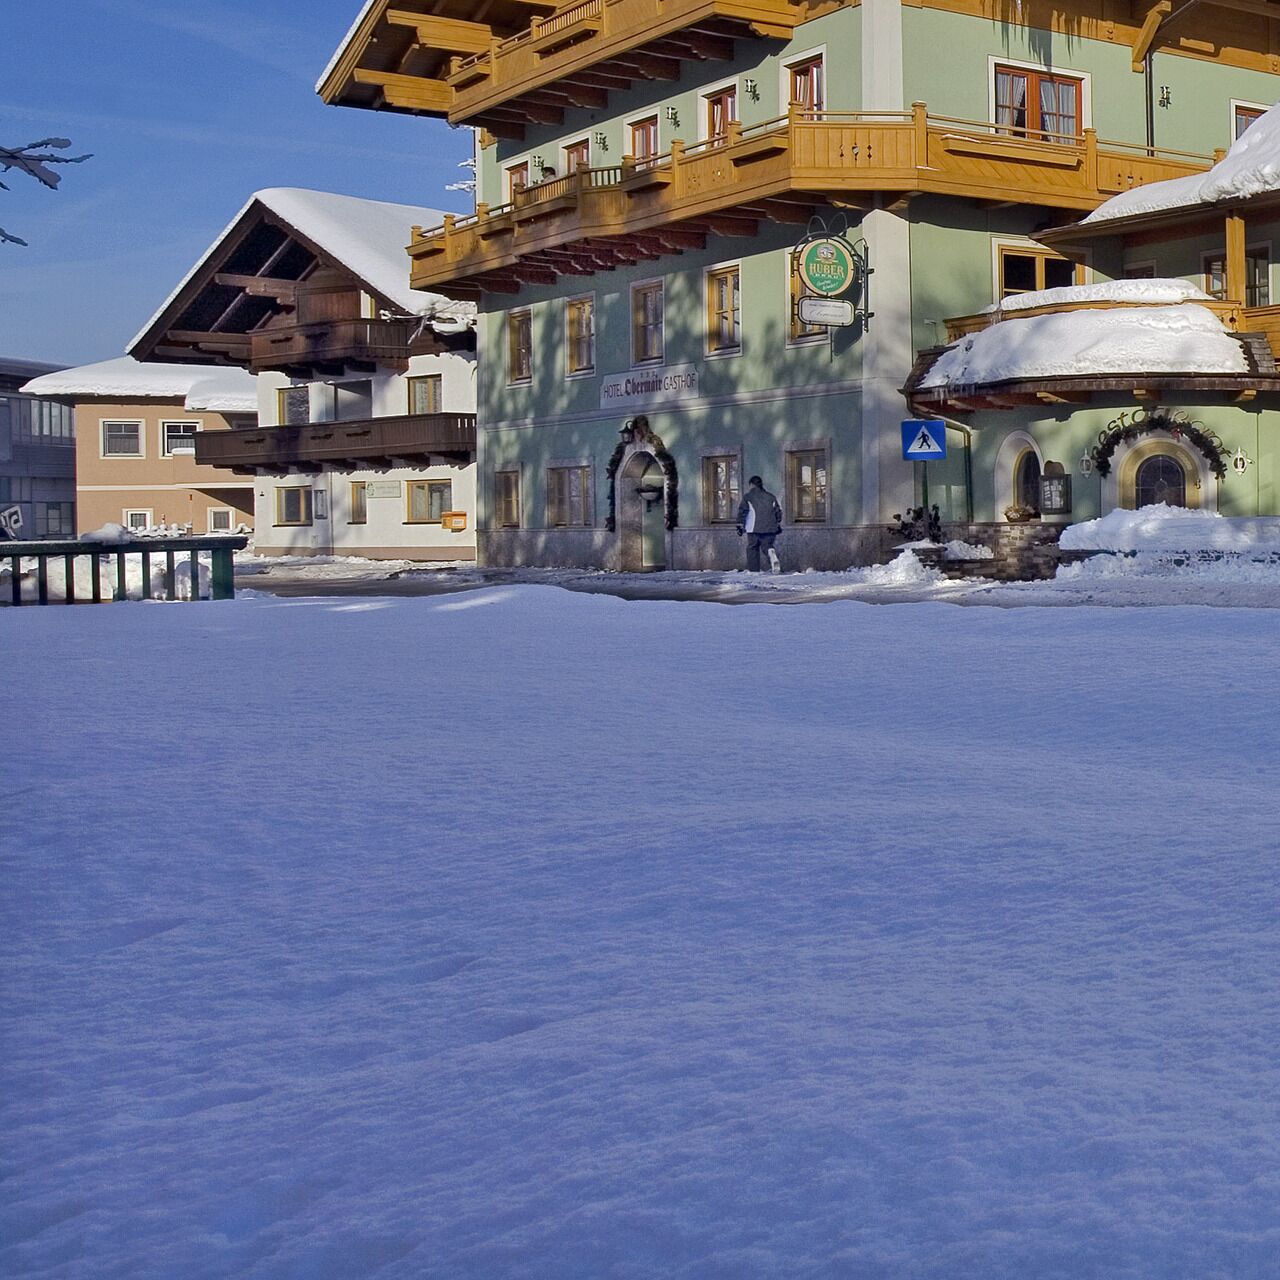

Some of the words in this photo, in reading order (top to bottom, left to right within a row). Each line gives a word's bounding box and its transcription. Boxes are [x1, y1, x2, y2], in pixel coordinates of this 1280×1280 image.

[809, 263, 845, 278] HUBER
[604, 384, 624, 399] HOTEL
[663, 373, 696, 391] GASTHOF
